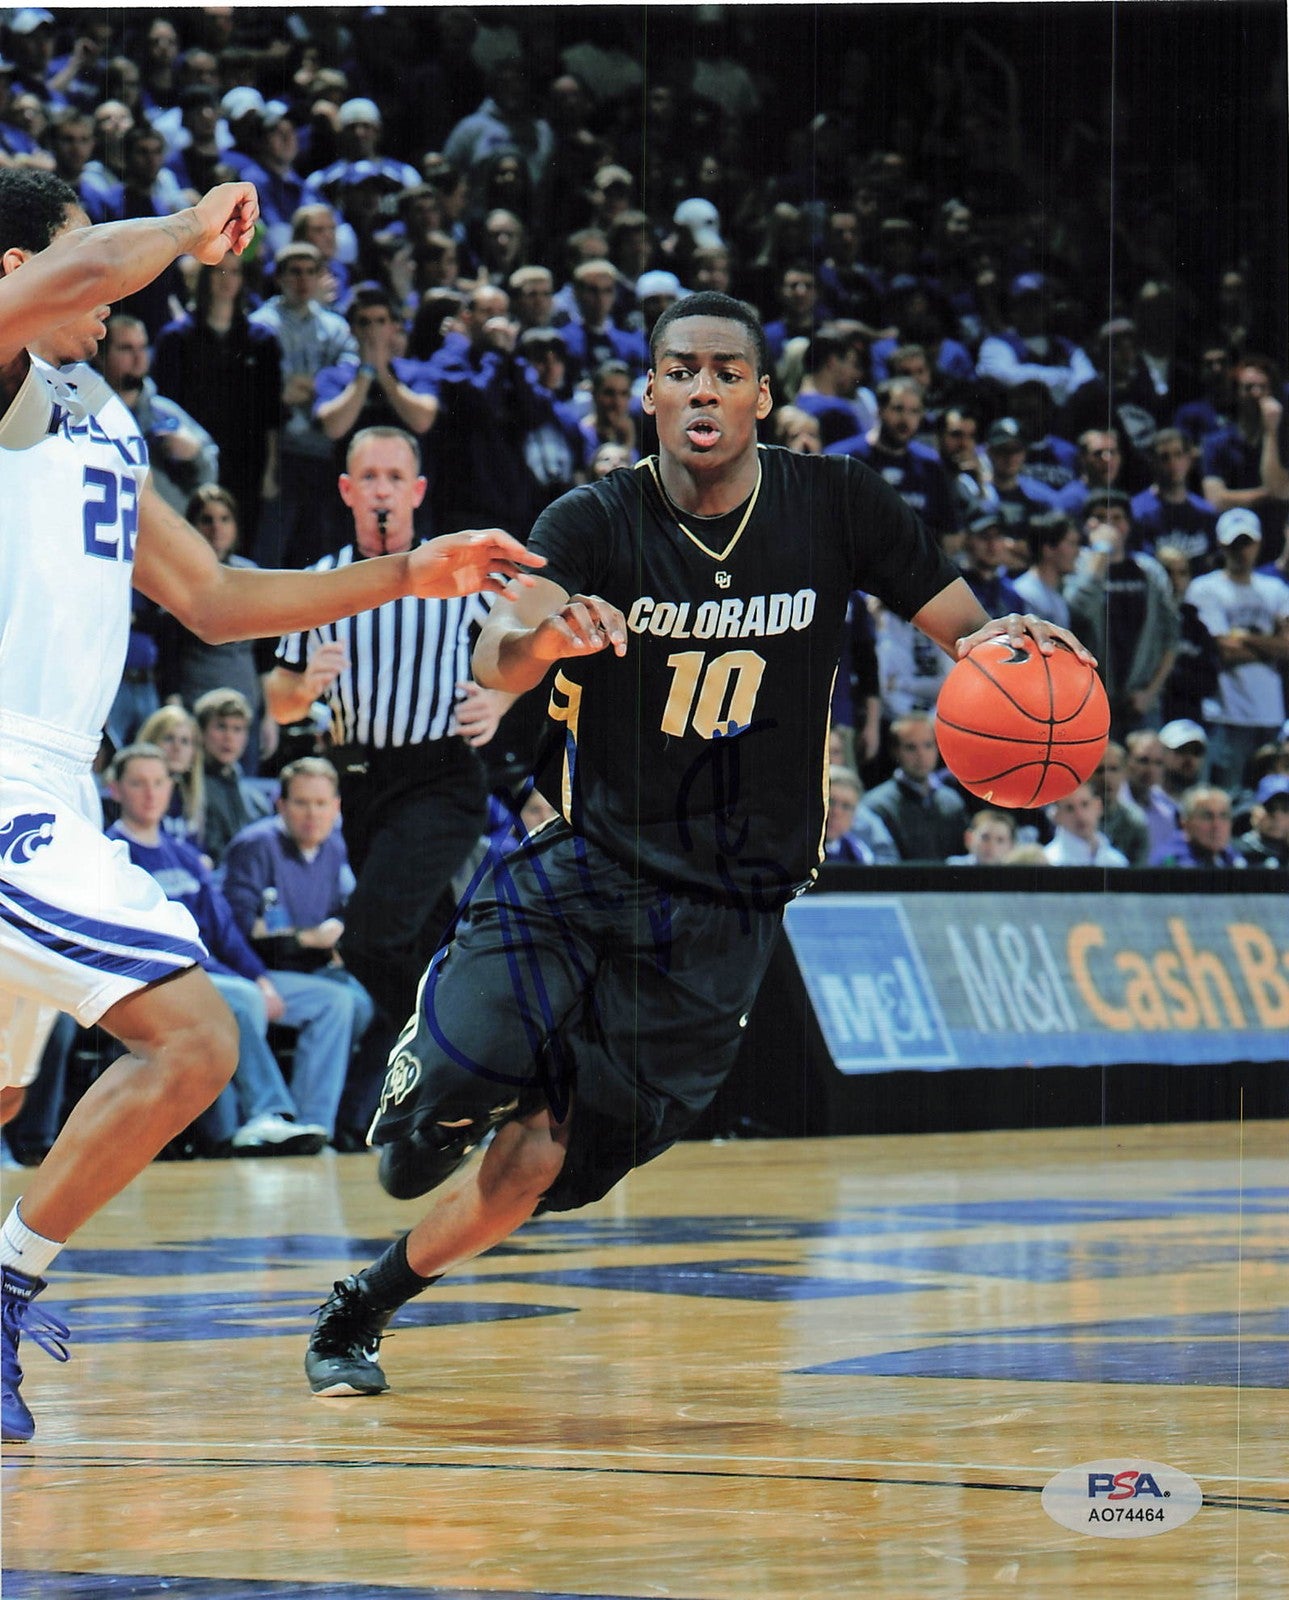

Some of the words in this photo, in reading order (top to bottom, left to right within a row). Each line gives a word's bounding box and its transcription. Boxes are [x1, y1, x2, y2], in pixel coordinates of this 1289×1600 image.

[627, 588, 817, 640] COLORADO
[660, 650, 767, 740] 10
[946, 922, 1080, 1034] M&I
[1066, 917, 1247, 1031] Cash
[1227, 922, 1288, 1030] B
